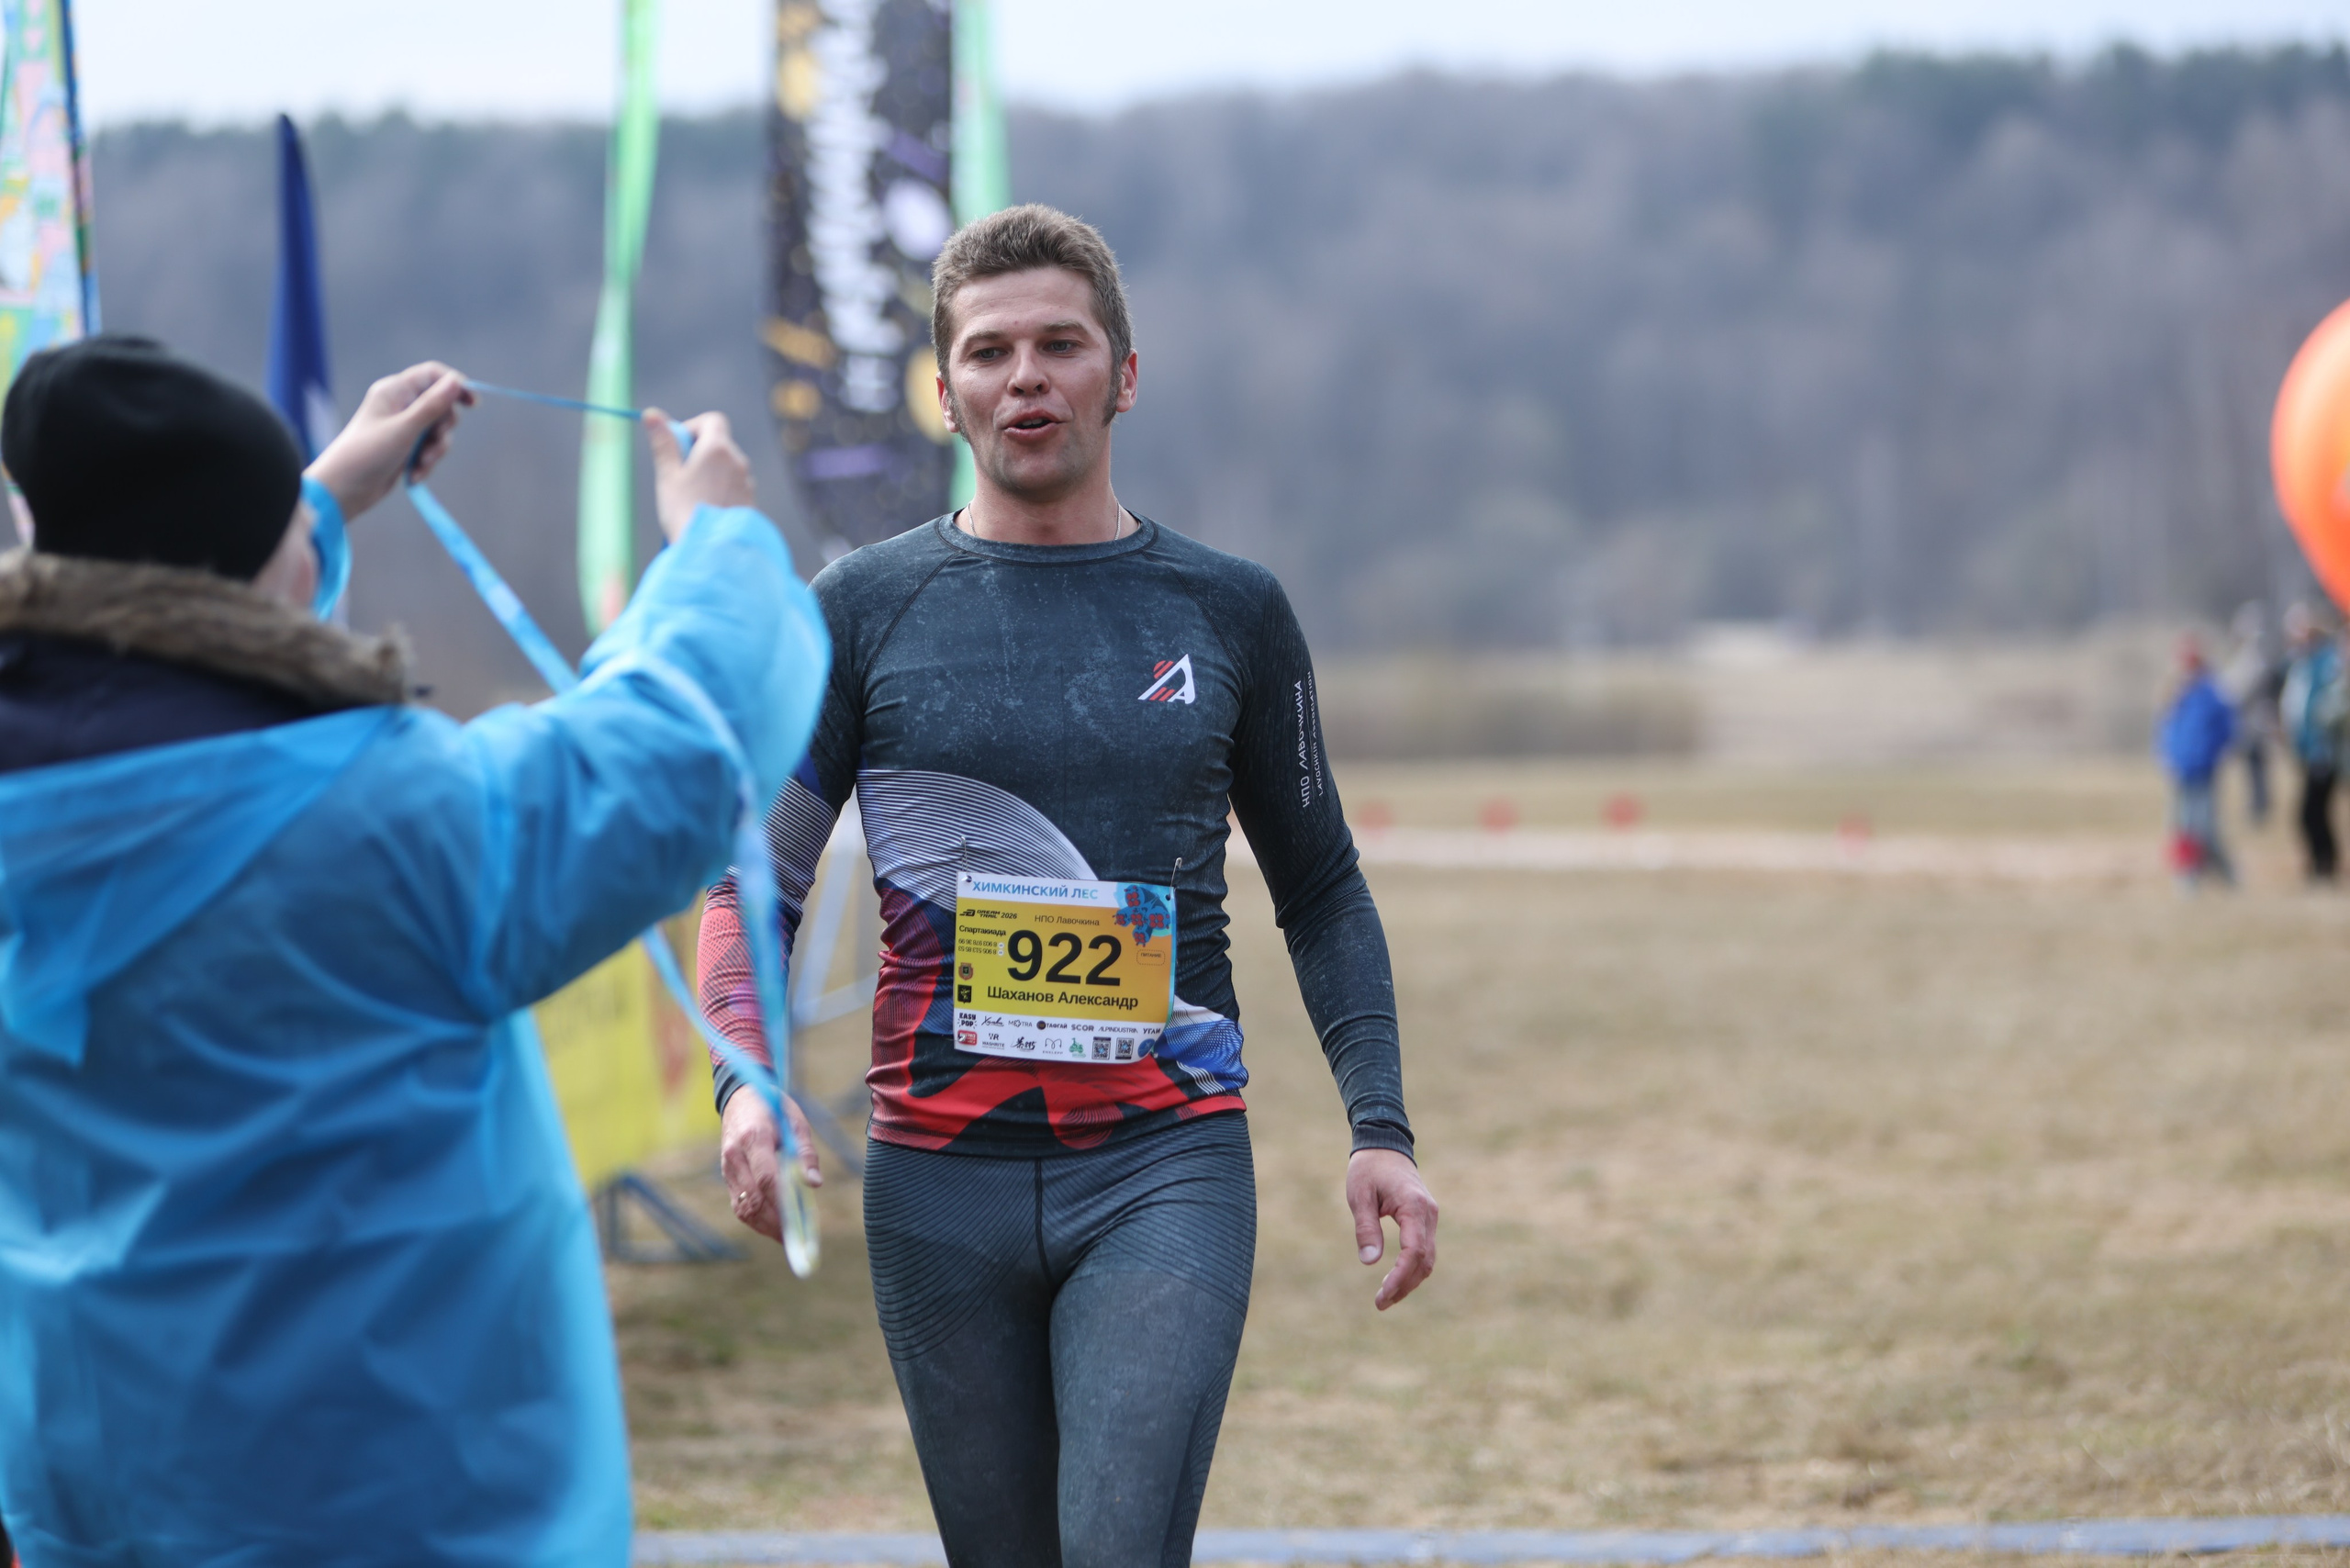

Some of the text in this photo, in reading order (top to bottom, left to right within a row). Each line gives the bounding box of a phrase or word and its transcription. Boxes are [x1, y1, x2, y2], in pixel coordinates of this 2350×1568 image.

[1293, 679, 1310, 808] НПО ЛАВОЧКИНА
[1307, 670, 1324, 797] LAVOCHKIN ASSOCIATION
[972, 880, 1099, 900] ХИМКИНСКИЙ ЛЕС
[958, 924, 1007, 936] Спартакиада
[1034, 914, 1100, 926] НПО Лавочкина
[1007, 929, 1122, 987] 922
[987, 985, 1138, 1011] Шаханов Александр
[1071, 1024, 1094, 1032] SCOR
[1098, 1025, 1138, 1034] ALPINDUSTRIA
